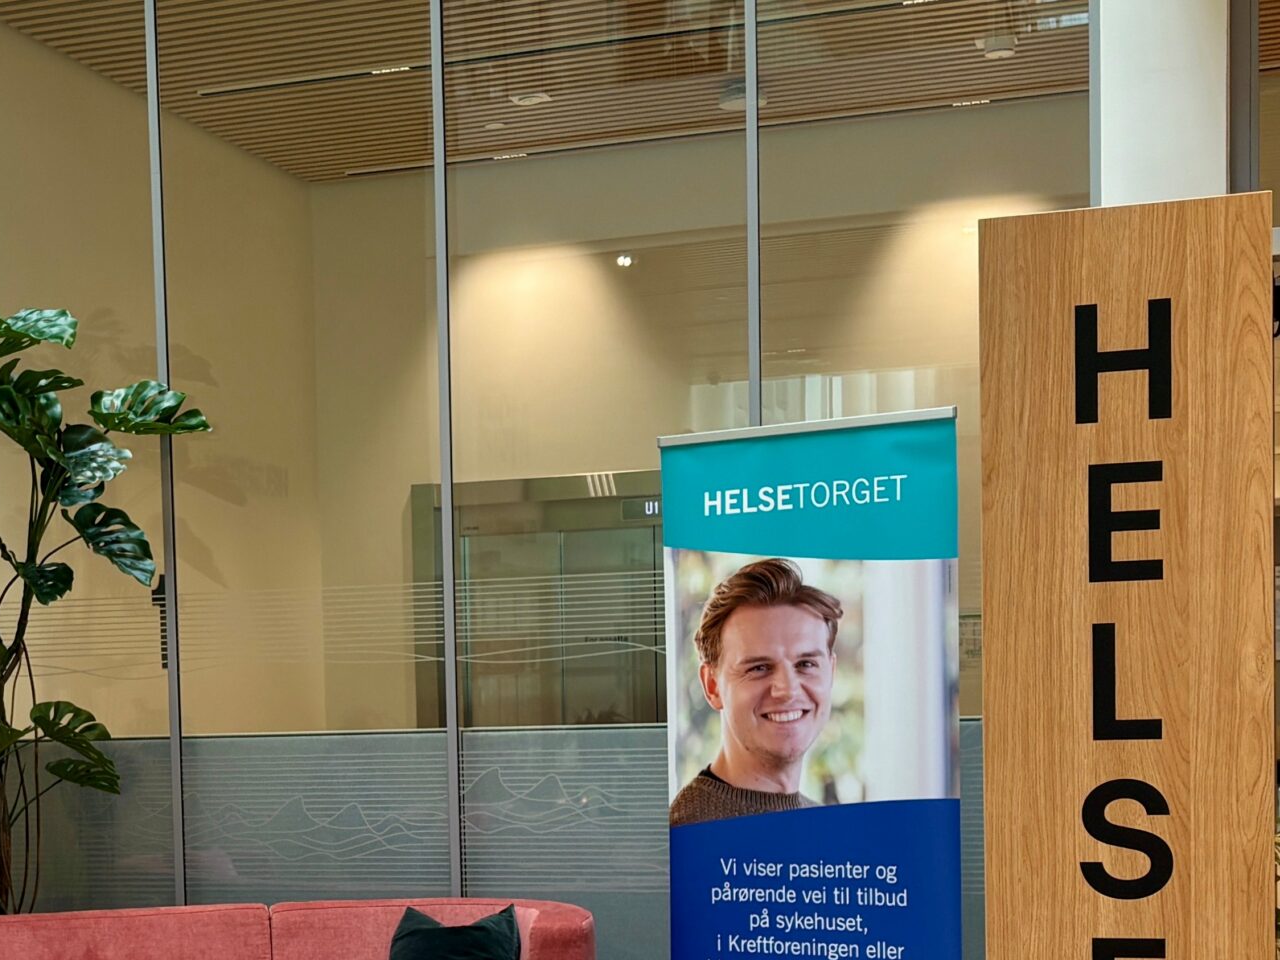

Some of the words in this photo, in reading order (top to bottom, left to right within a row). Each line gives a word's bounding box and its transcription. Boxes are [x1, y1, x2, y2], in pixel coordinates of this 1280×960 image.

[704, 474, 908, 516] HELSETORGET
[720, 858, 737, 876] Vi
[743, 859, 783, 877] viser
[789, 860, 870, 881] pasienter
[876, 865, 897, 883] og
[711, 881, 797, 904] pårørende
[802, 887, 826, 904] vei
[833, 887, 849, 905] til
[857, 888, 907, 906] tilbud
[749, 908, 770, 930] på
[776, 911, 868, 934] sykehuset,
[717, 935, 721, 951] i
[729, 935, 859, 960] Kreftforeningen
[866, 941, 904, 960] eller
